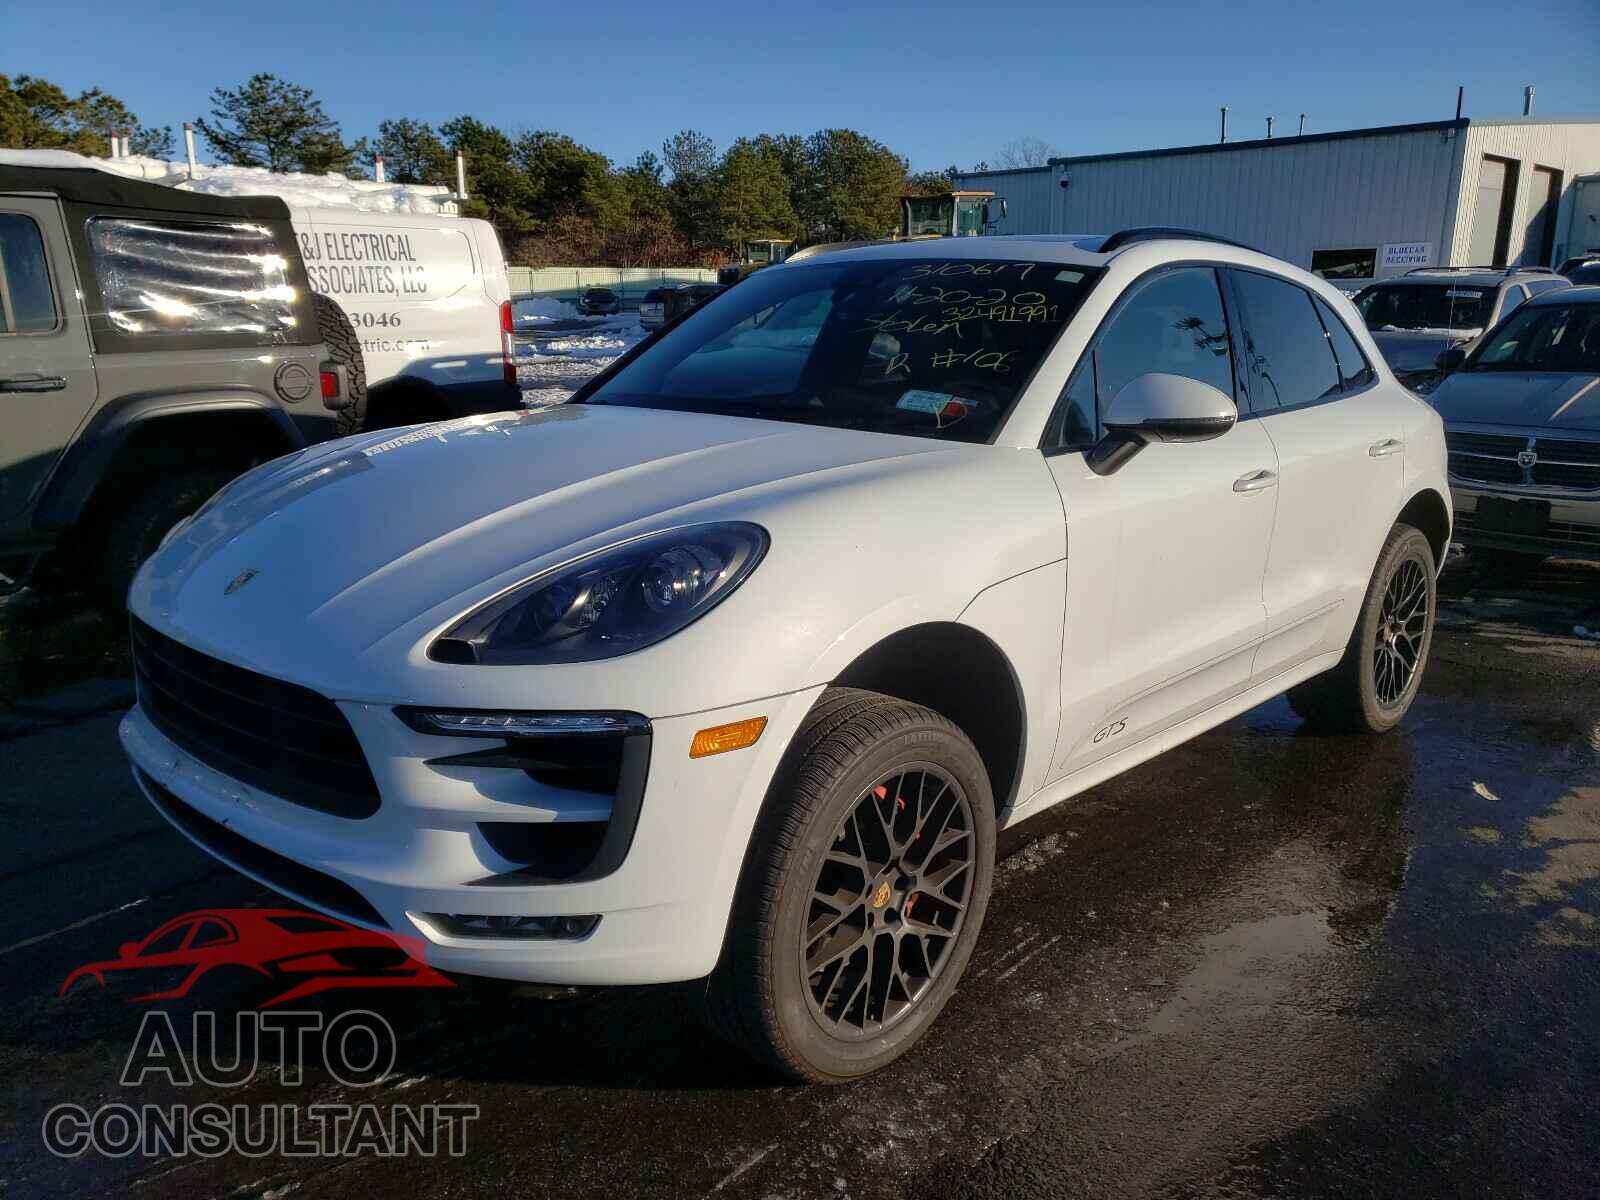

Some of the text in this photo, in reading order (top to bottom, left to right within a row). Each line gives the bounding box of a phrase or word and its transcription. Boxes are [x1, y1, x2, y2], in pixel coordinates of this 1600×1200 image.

[294, 232, 417, 261] &J ELECTRICAL
[1385, 255, 1428, 264] RECEIVING
[307, 265, 400, 297] SSOCIATES,
[1093, 716, 1128, 743] GTS
